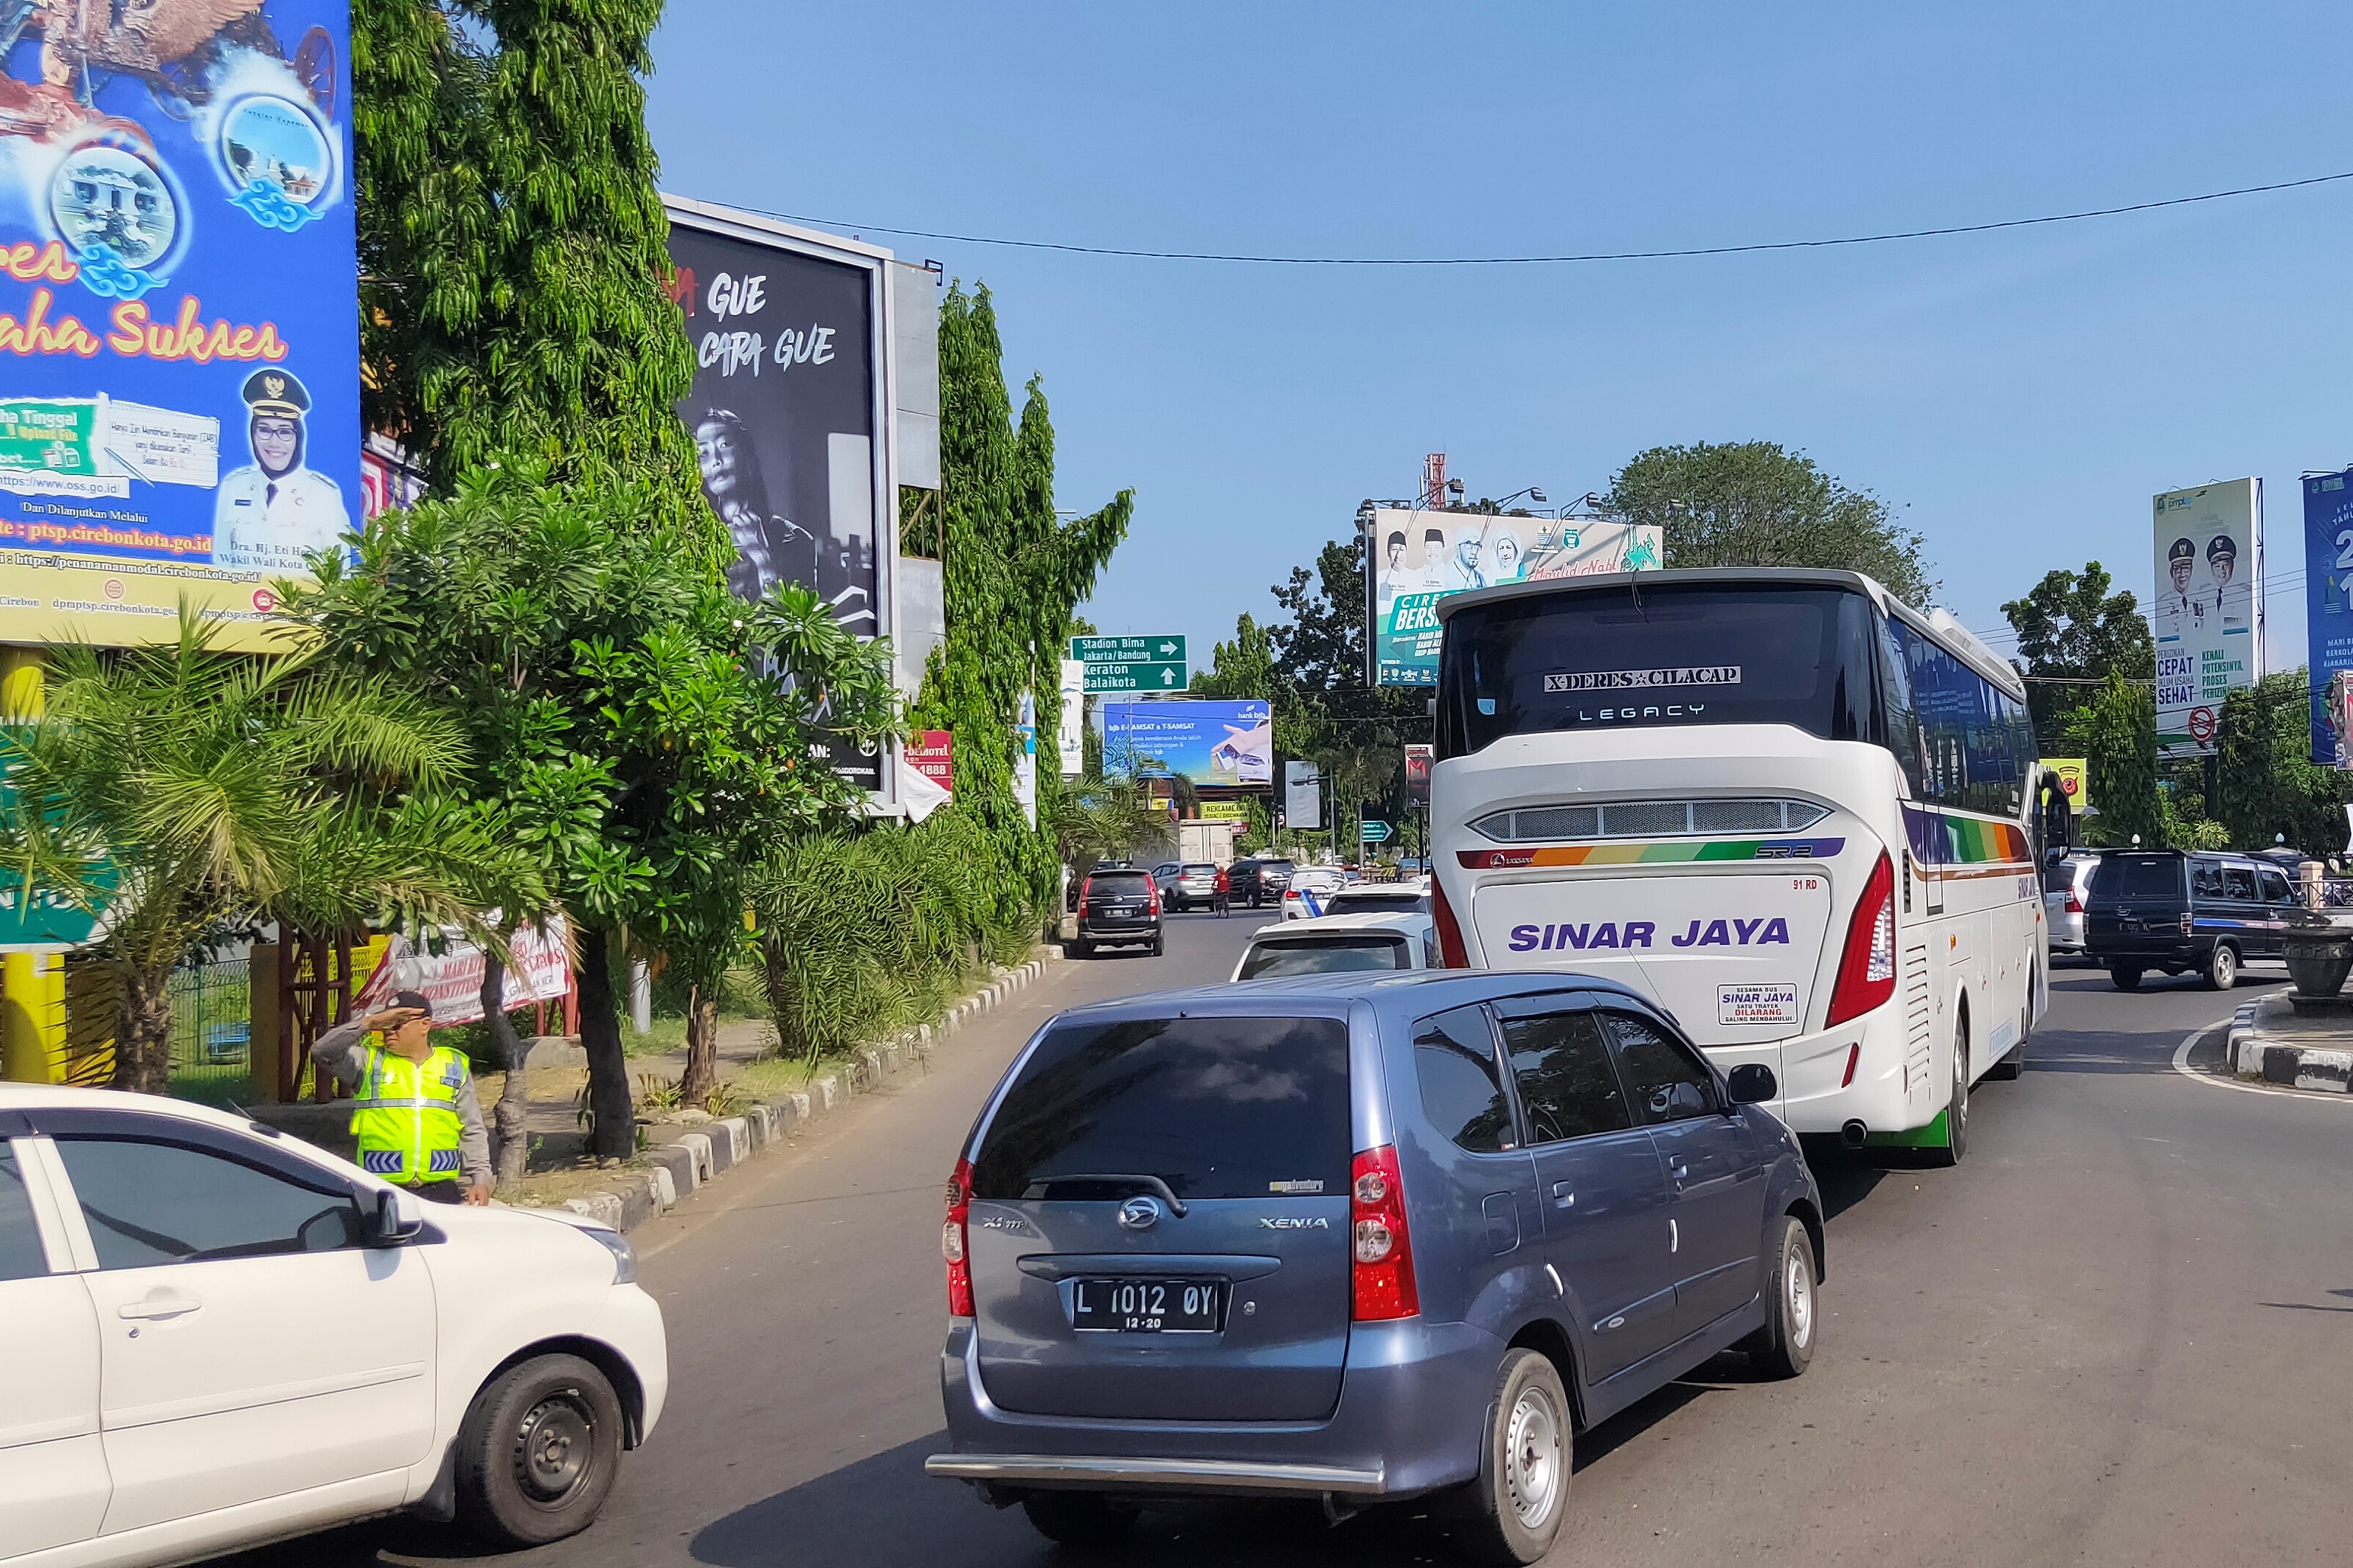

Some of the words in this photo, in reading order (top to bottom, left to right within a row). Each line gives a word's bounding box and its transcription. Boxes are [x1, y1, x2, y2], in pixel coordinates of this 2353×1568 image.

[707, 272, 766, 322] GUE
[110, 296, 286, 362] Sukses
[699, 332, 769, 378] CARA
[774, 323, 836, 372] GUE
[21, 409, 77, 429] Tinggal
[23, 502, 44, 513] Dan
[47, 504, 107, 519] Dilanjutkan
[110, 510, 148, 523] Melalui
[30, 525, 212, 552] ptsp.cirebonkota.go.id
[220, 554, 249, 566] Wakil
[253, 557, 275, 568] Wali
[279, 558, 302, 569] Kota
[1581, 558, 1617, 575] Nabi
[0, 596, 39, 606] Cirebon
[1401, 593, 1450, 608] CIRE
[1082, 639, 1117, 649] Stadion
[1122, 638, 1145, 648] Bima
[1083, 651, 1151, 662] Jakarta/Bandung
[2158, 648, 2185, 659] PERIZINAN
[2202, 649, 2224, 661] KENALI
[1084, 665, 1129, 675] Keraton
[2158, 656, 2193, 676] CEPAT
[1084, 677, 1136, 688] Balaikota
[1548, 672, 1635, 691] X-DERES
[1648, 668, 1737, 684] CILACAP
[2174, 675, 2194, 686] USAHA
[2202, 674, 2227, 686] PROSES
[2158, 685, 2194, 704] SEHAT
[1580, 704, 1705, 721] LEGACY
[1793, 879, 1803, 890] 91
[1805, 879, 1817, 890] RD
[1508, 921, 1655, 951] SINAR
[1671, 917, 1790, 947] JAYA
[1722, 993, 1760, 1003] SINAR
[1764, 993, 1793, 1002] JAYA
[1257, 1217, 1328, 1229] XENIA
[1077, 1283, 1092, 1313] L
[1112, 1285, 1165, 1314] 1012
